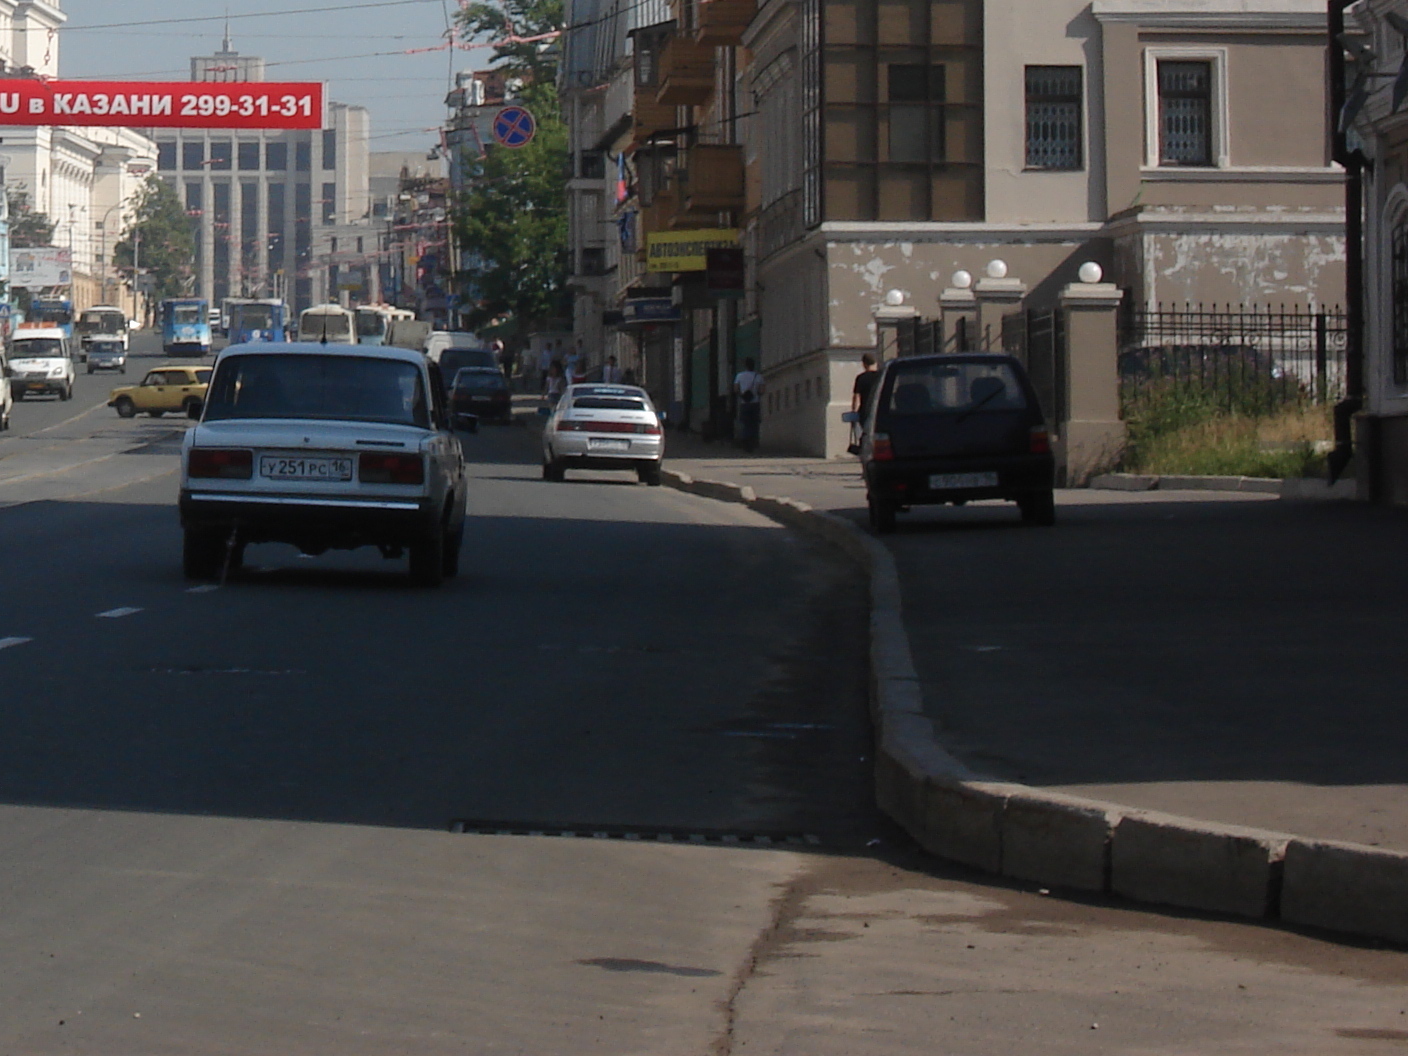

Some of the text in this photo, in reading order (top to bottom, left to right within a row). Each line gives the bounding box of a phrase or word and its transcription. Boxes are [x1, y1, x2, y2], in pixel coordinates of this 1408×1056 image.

[28, 97, 45, 113] в
[53, 94, 173, 115] КАЗАНИ
[180, 94, 312, 117] 299-31-31
